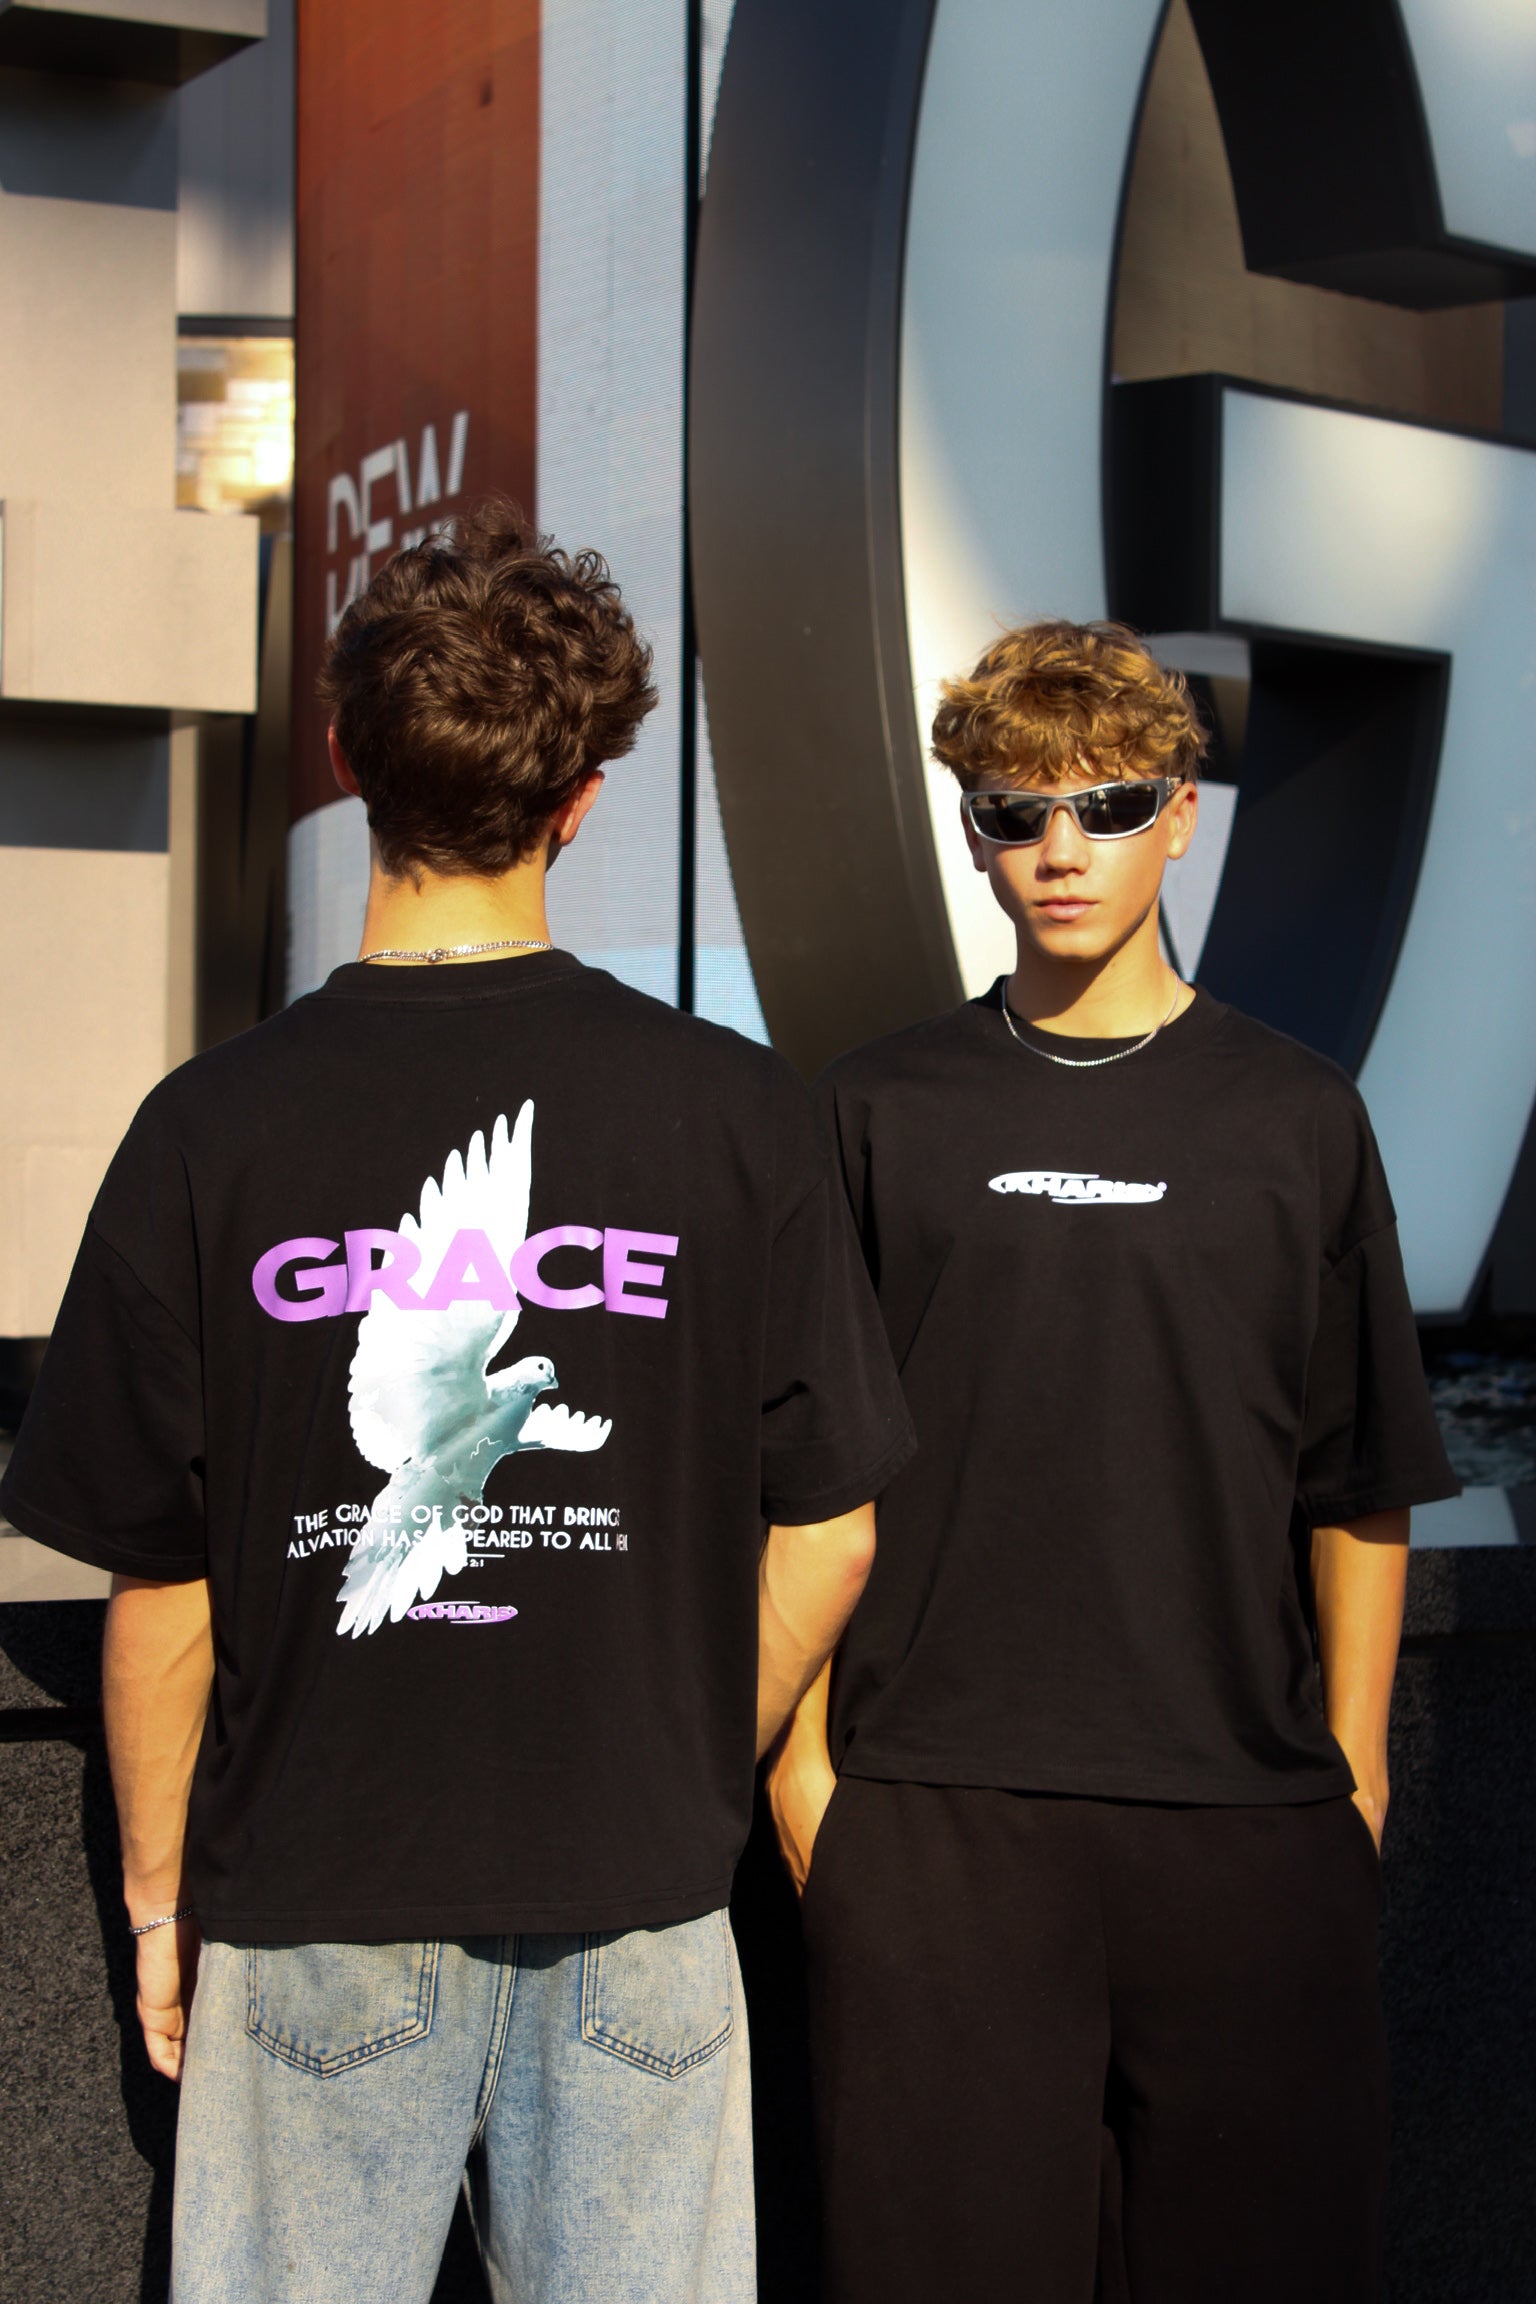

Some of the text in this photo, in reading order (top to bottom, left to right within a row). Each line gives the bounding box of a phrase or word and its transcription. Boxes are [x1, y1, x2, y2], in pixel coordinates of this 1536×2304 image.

[252, 1225, 679, 1322] GRACE
[294, 1504, 620, 1535] THE GRACE OF GOD THAT BRING
[462, 1529, 534, 1549] PEARED
[540, 1531, 572, 1550] TO
[579, 1532, 612, 1551] ALL
